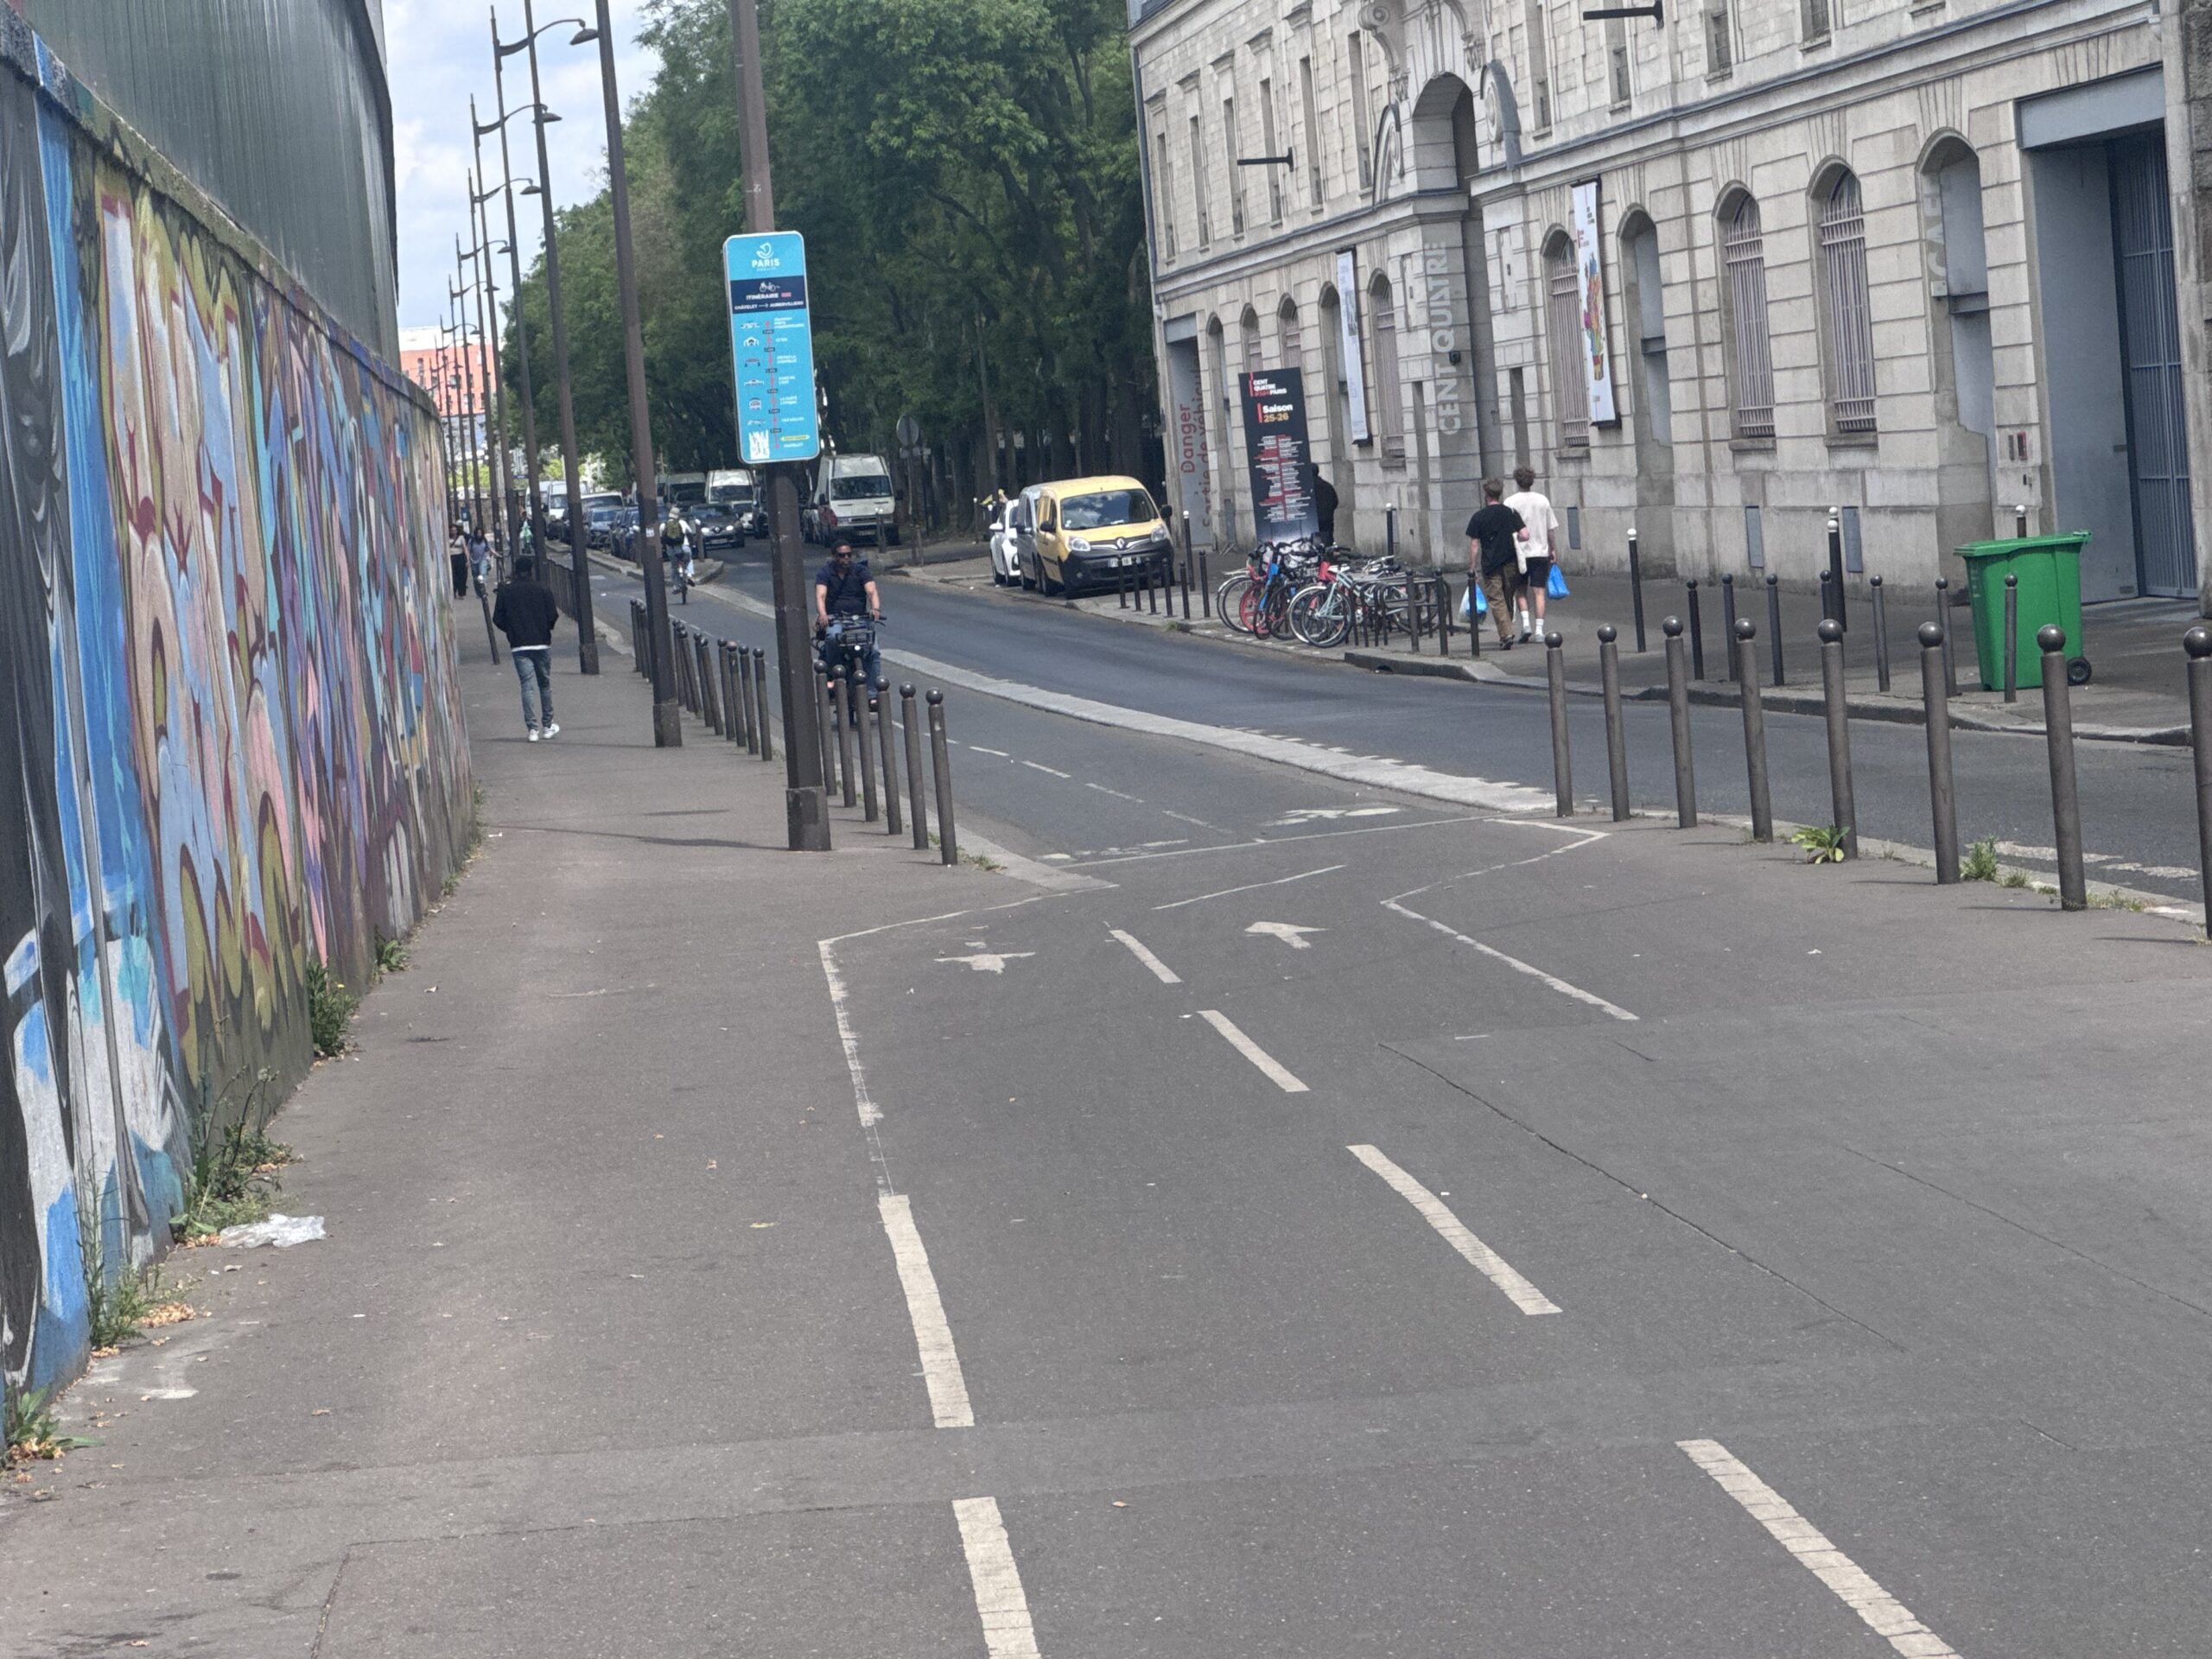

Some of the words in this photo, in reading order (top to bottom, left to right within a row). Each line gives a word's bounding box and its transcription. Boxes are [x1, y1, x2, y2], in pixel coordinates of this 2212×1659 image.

[752, 258, 780, 268] PARIS
[1425, 241, 1454, 353] QUATRE
[1262, 404, 1293, 414] Saison
[1263, 412, 1289, 423] 25-26
[1434, 362, 1461, 435] CENT
[1179, 404, 1197, 474] Danger
